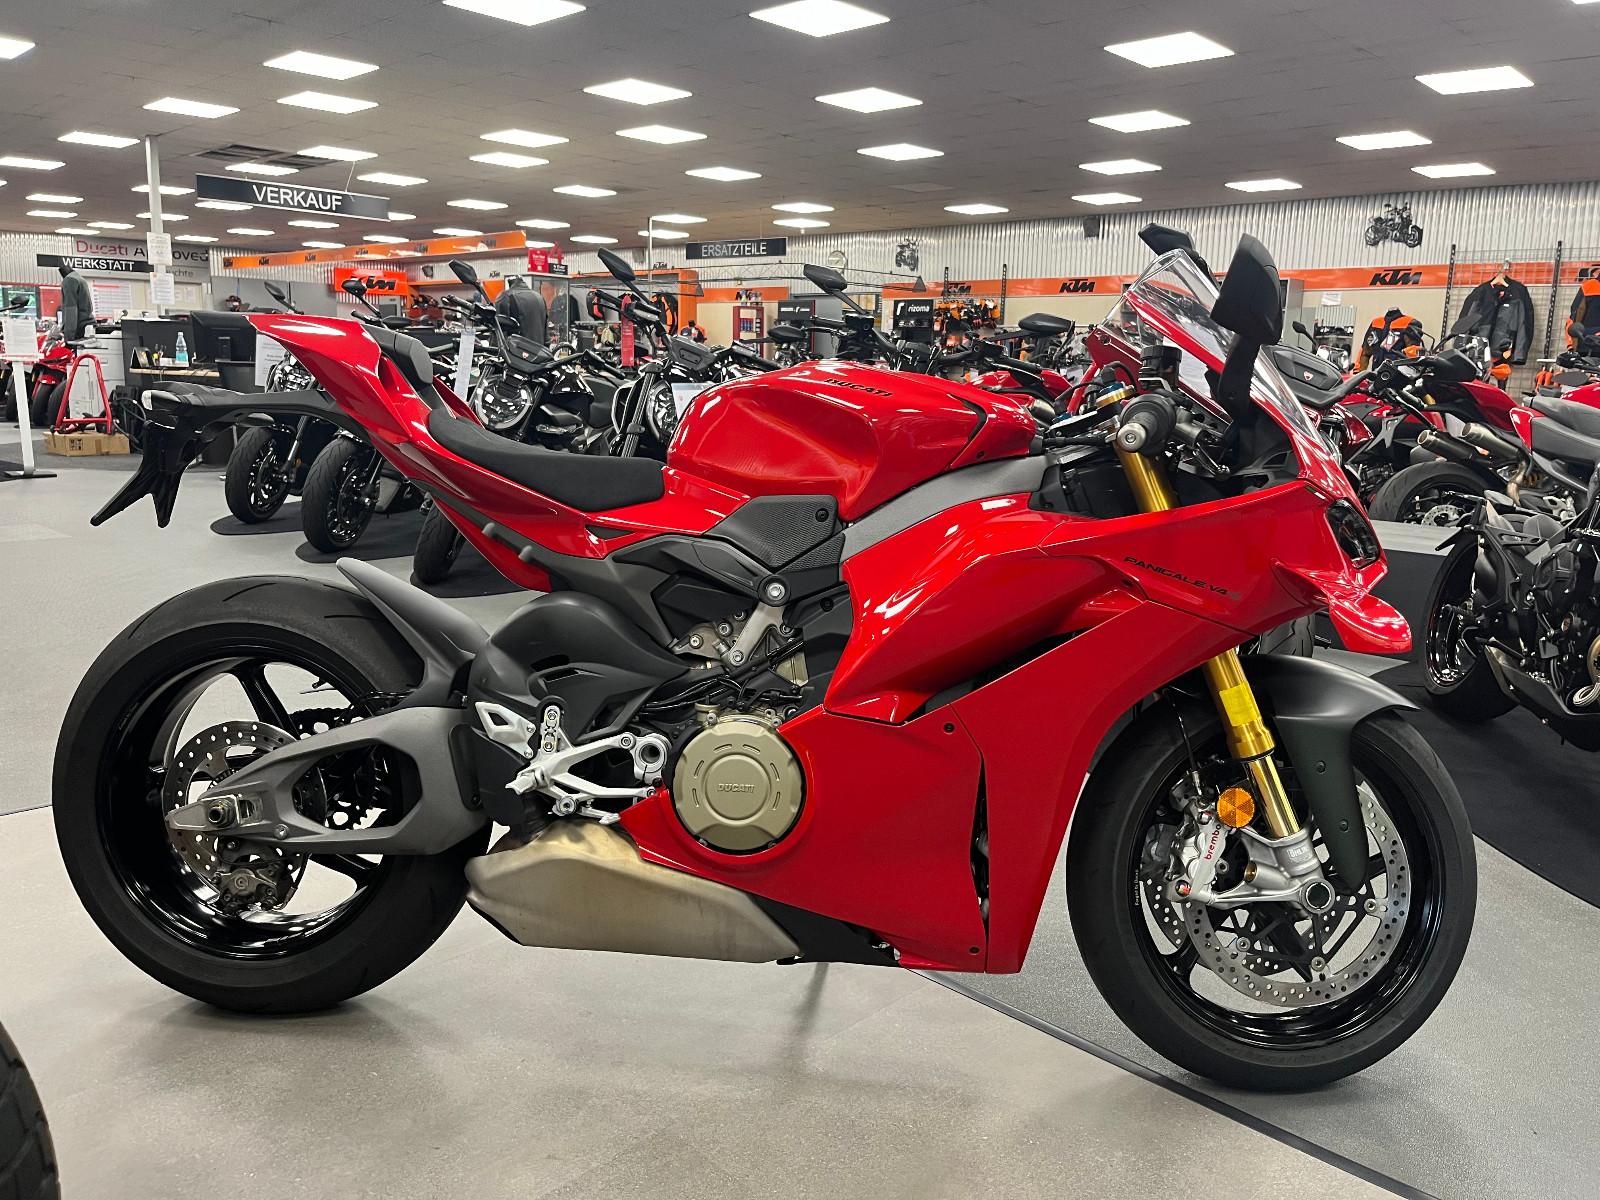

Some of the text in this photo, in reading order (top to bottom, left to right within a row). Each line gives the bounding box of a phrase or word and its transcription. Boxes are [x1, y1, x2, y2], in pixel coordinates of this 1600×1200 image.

[252, 184, 343, 211] VERKAUF
[76, 239, 128, 256] Ducati
[133, 246, 209, 262] Aoved
[701, 242, 767, 257] ERSATZTEILE
[62, 256, 135, 272] WERKSTATT
[1059, 278, 1096, 293] KTM
[1369, 268, 1423, 286] KTM
[907, 304, 930, 313] rizoma
[824, 378, 893, 397] DUCATI
[1123, 556, 1228, 595] PANIGALE V4
[717, 783, 755, 794] DUCATI
[1203, 823, 1222, 861] brembo
